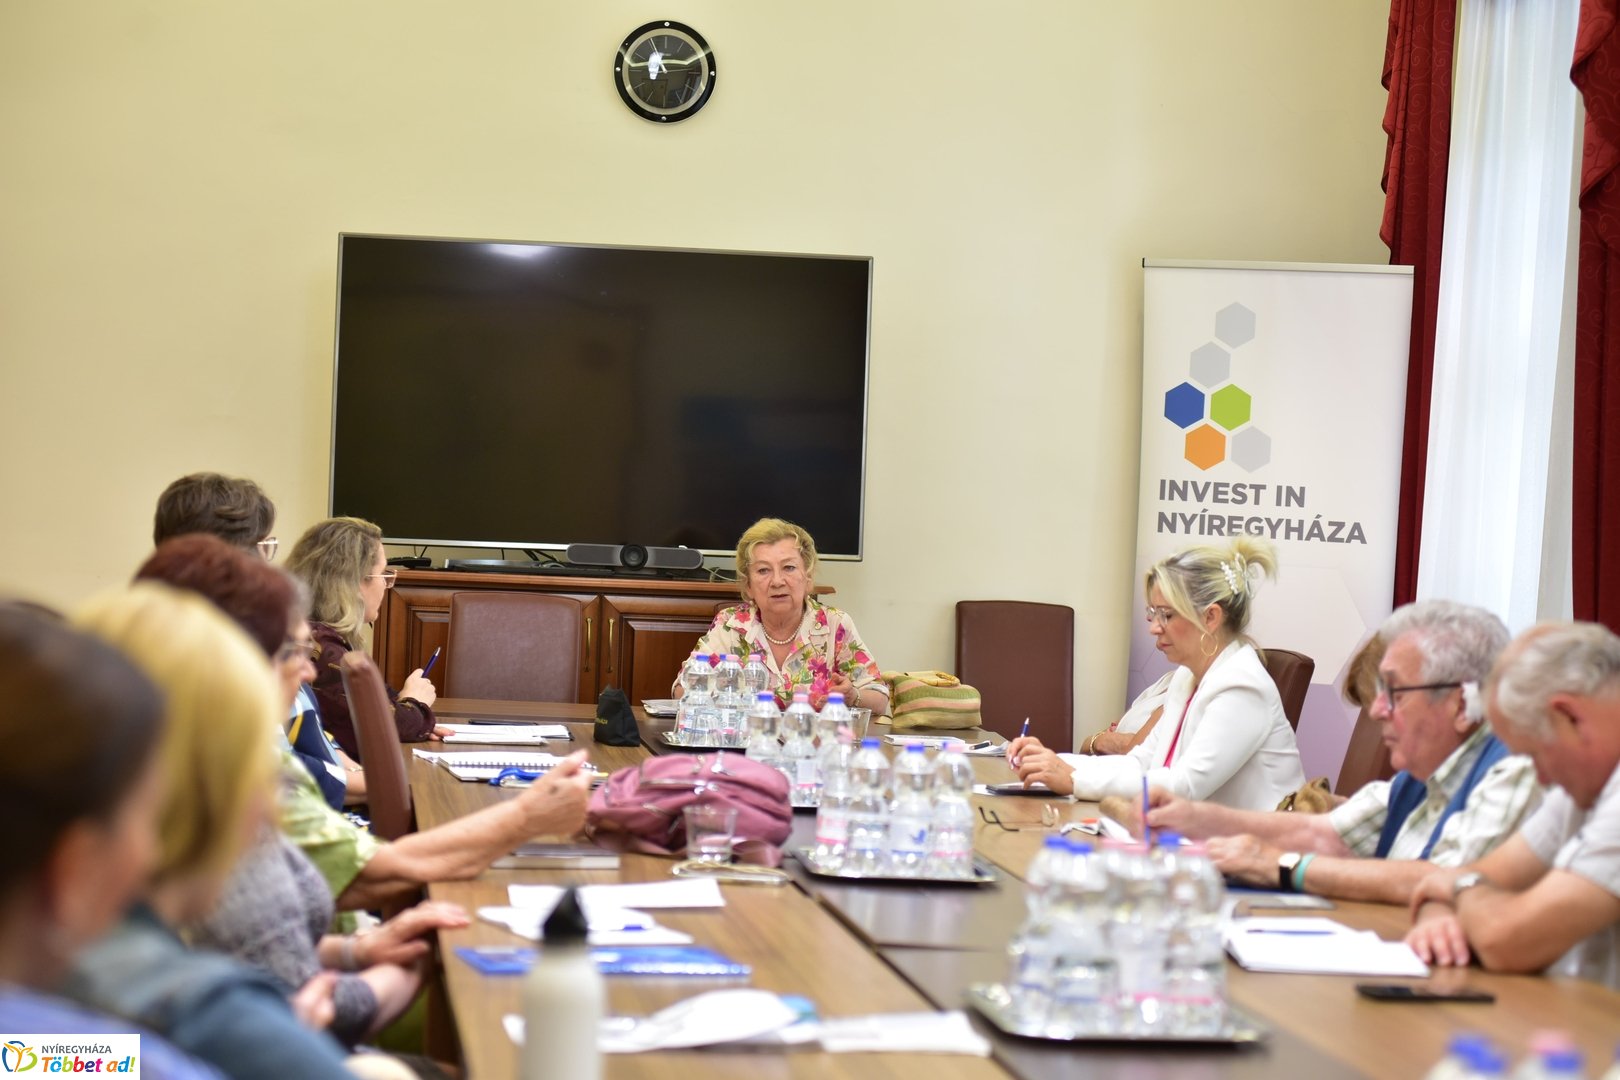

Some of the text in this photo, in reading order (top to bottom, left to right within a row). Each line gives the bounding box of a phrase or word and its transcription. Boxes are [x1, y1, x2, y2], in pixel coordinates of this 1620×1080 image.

[1159, 479, 1306, 508] INVEST IN
[1157, 508, 1368, 545] NYÍREGYHÁZA
